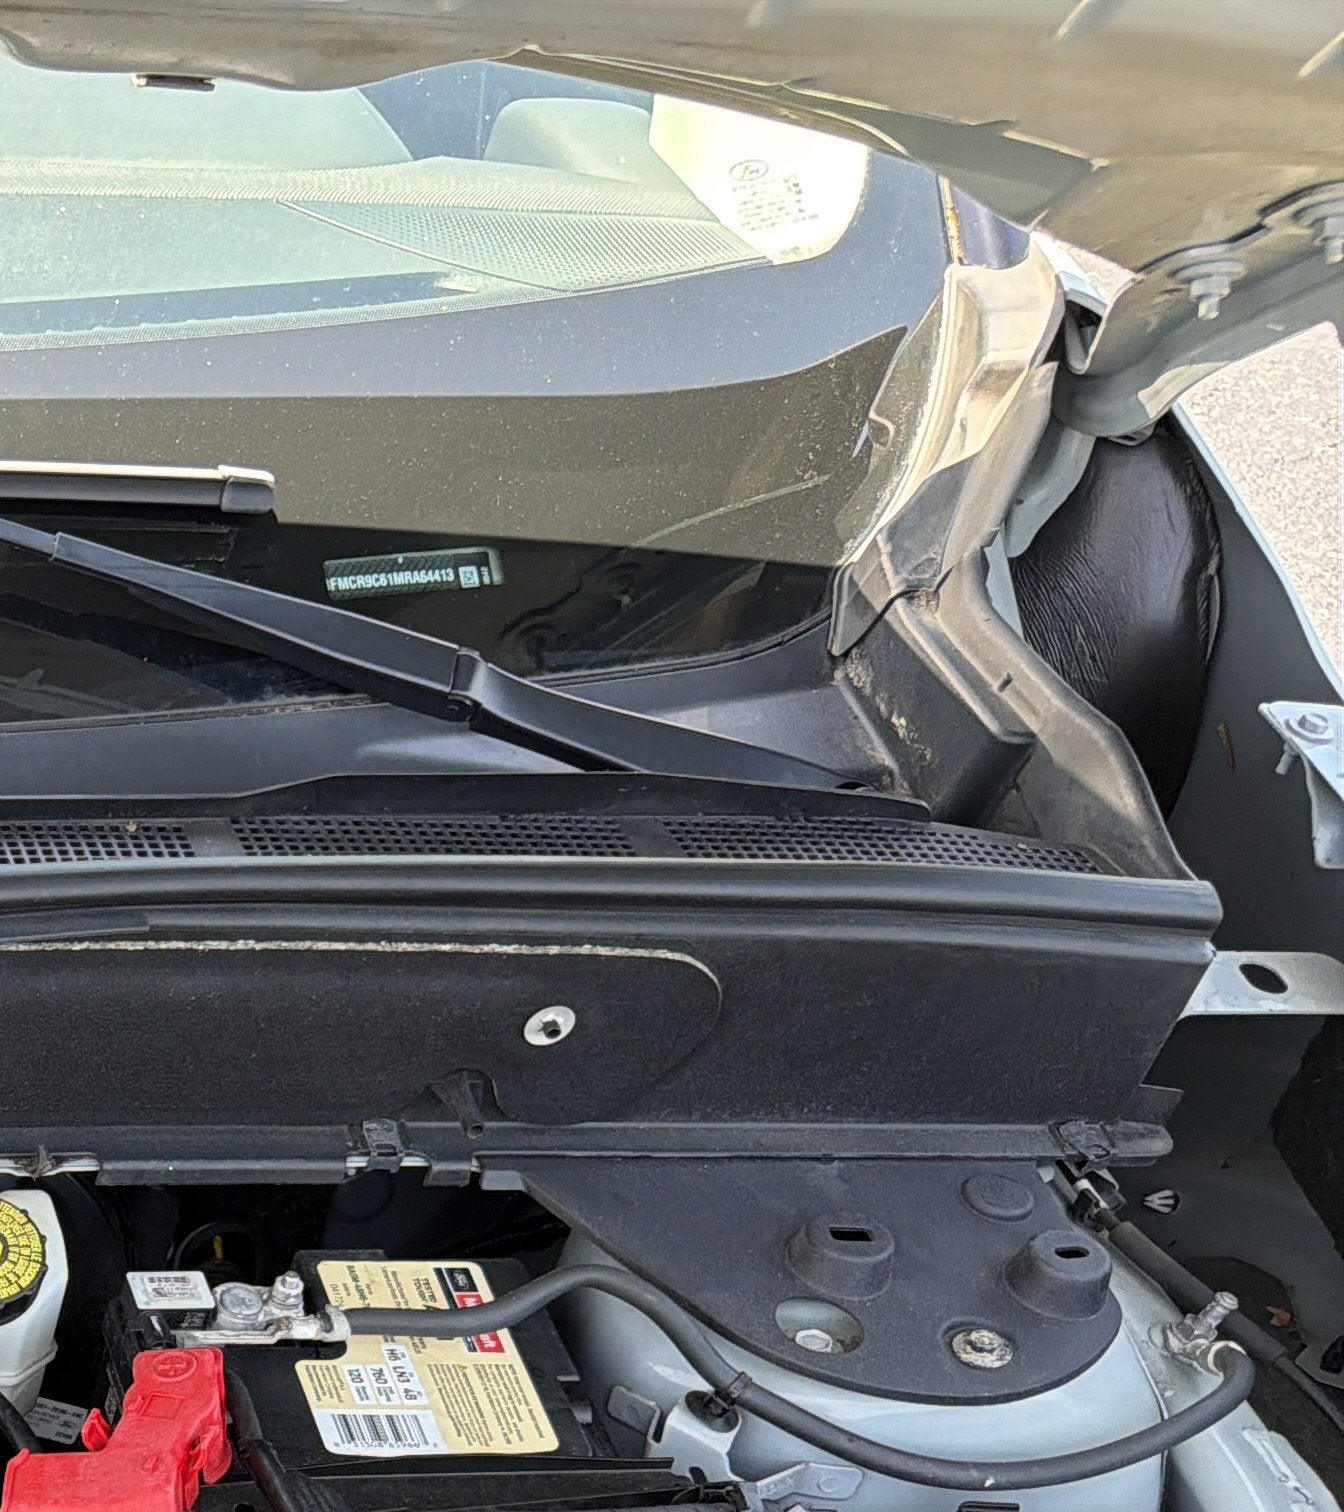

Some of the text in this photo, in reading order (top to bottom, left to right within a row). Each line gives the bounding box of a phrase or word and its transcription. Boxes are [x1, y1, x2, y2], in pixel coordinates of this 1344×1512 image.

[420, 1277, 437, 1302] TESTED
[384, 1348, 401, 1361] H6
[346, 1367, 364, 1384] 120
[369, 1366, 388, 1384] 760
[391, 1365, 411, 1383] LN3
[401, 1387, 418, 1400] 48
